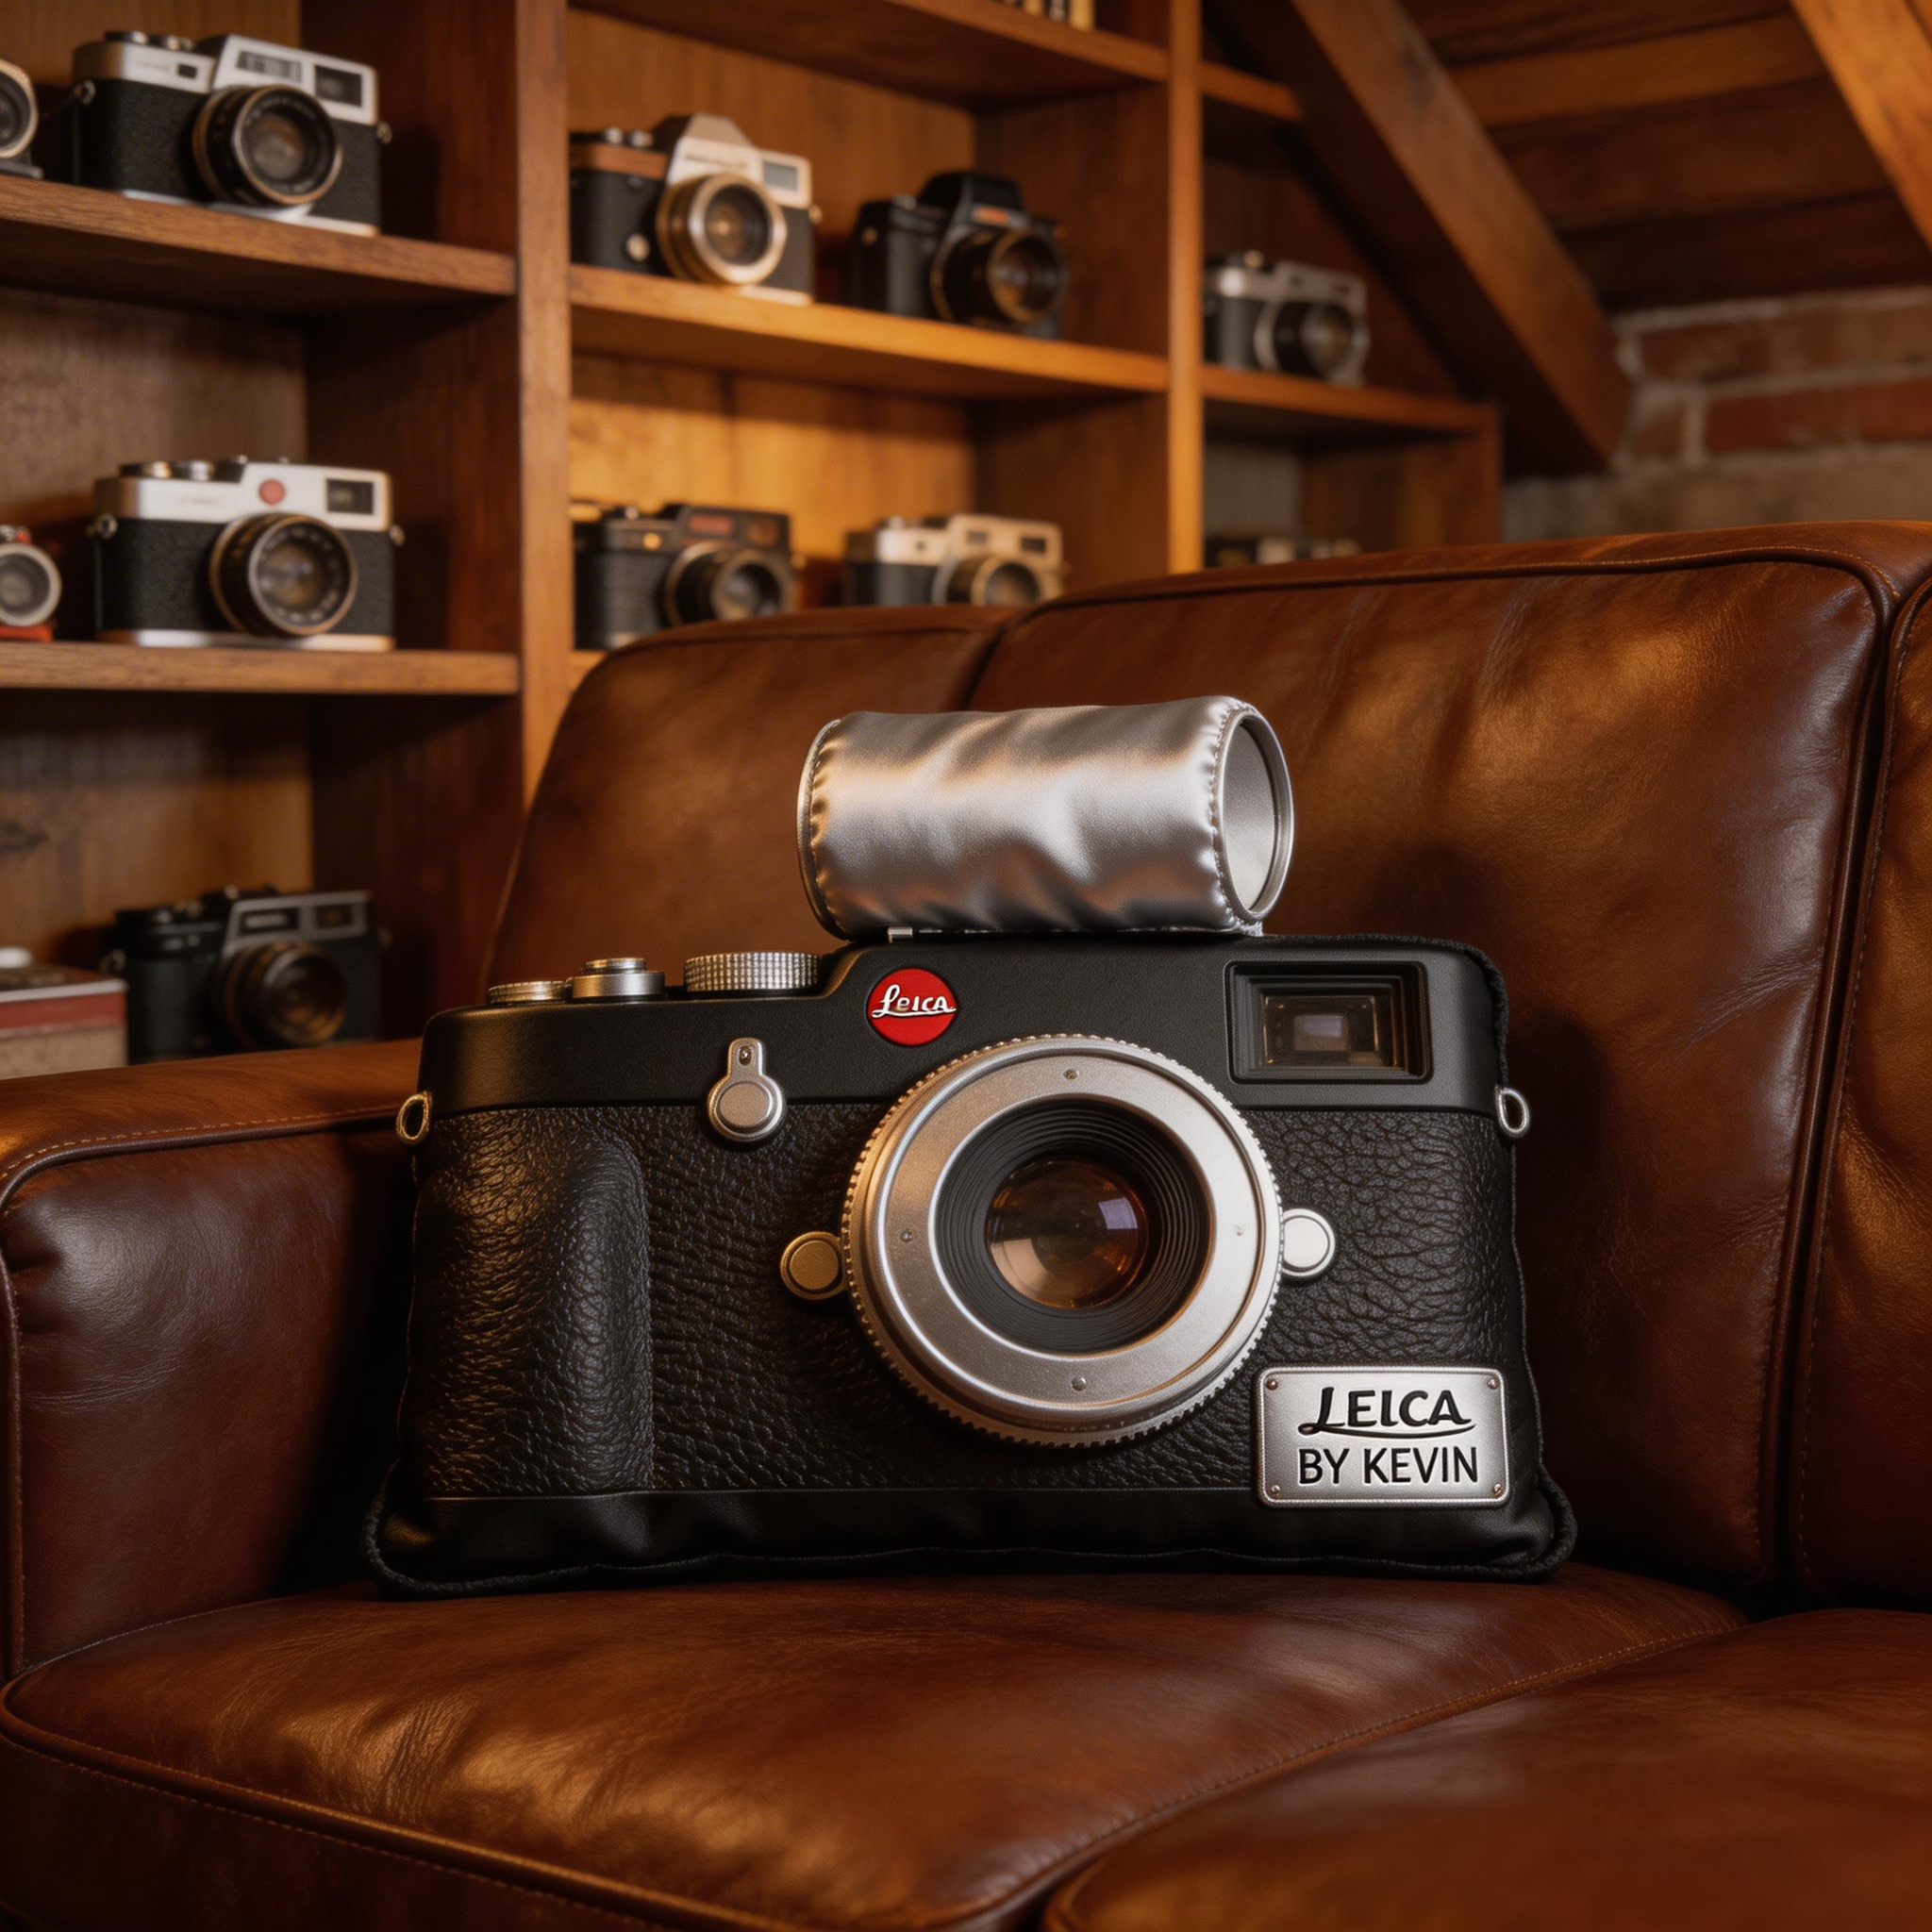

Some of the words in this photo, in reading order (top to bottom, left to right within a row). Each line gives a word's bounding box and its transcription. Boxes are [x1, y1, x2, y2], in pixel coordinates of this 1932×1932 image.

[872, 984, 957, 1018] Leica
[1298, 1387, 1476, 1439] LEICA
[1298, 1448, 1350, 1484] BY
[1363, 1446, 1478, 1484] KEVIN
